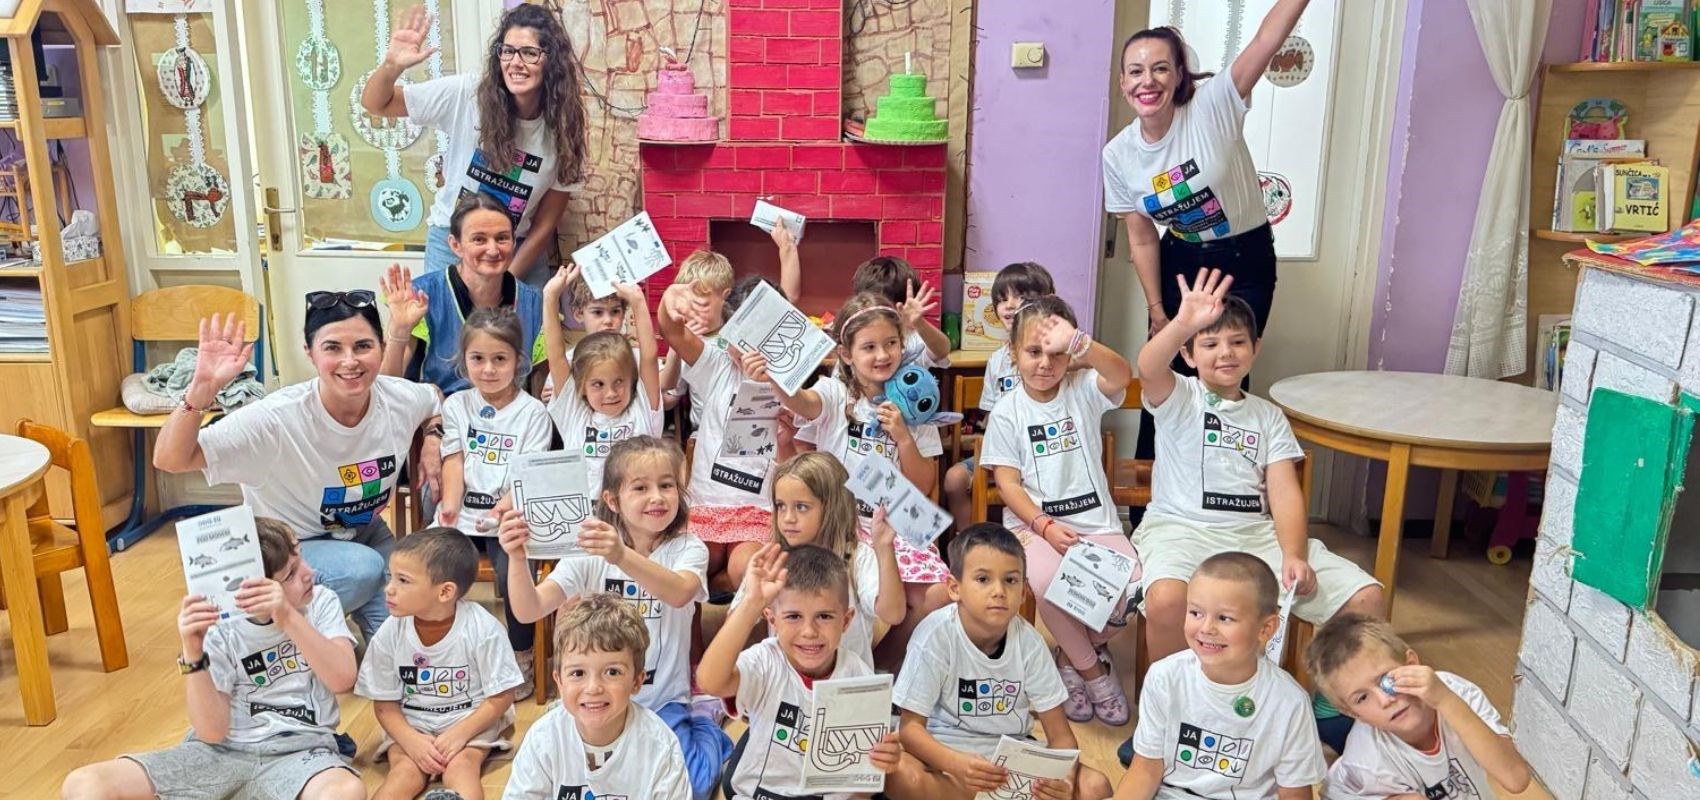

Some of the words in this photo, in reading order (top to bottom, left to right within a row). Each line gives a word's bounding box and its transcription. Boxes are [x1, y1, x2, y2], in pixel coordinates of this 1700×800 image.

[526, 159, 538, 168] JA
[1184, 164, 1195, 175] JA
[471, 167, 529, 196] ISTRAŽUJEM
[1625, 202, 1659, 216] VRTIĆ
[1207, 417, 1219, 425] JA
[1032, 429, 1043, 437] JA
[381, 460, 394, 471] JA
[713, 468, 760, 488] ISTRAŽUJEM
[608, 584, 621, 593] JA
[247, 658, 261, 669] JA
[402, 670, 415, 679] JA
[961, 685, 974, 693] JA
[781, 709, 794, 720] JA
[1183, 729, 1197, 741] JA
[561, 792, 577, 800] JA
